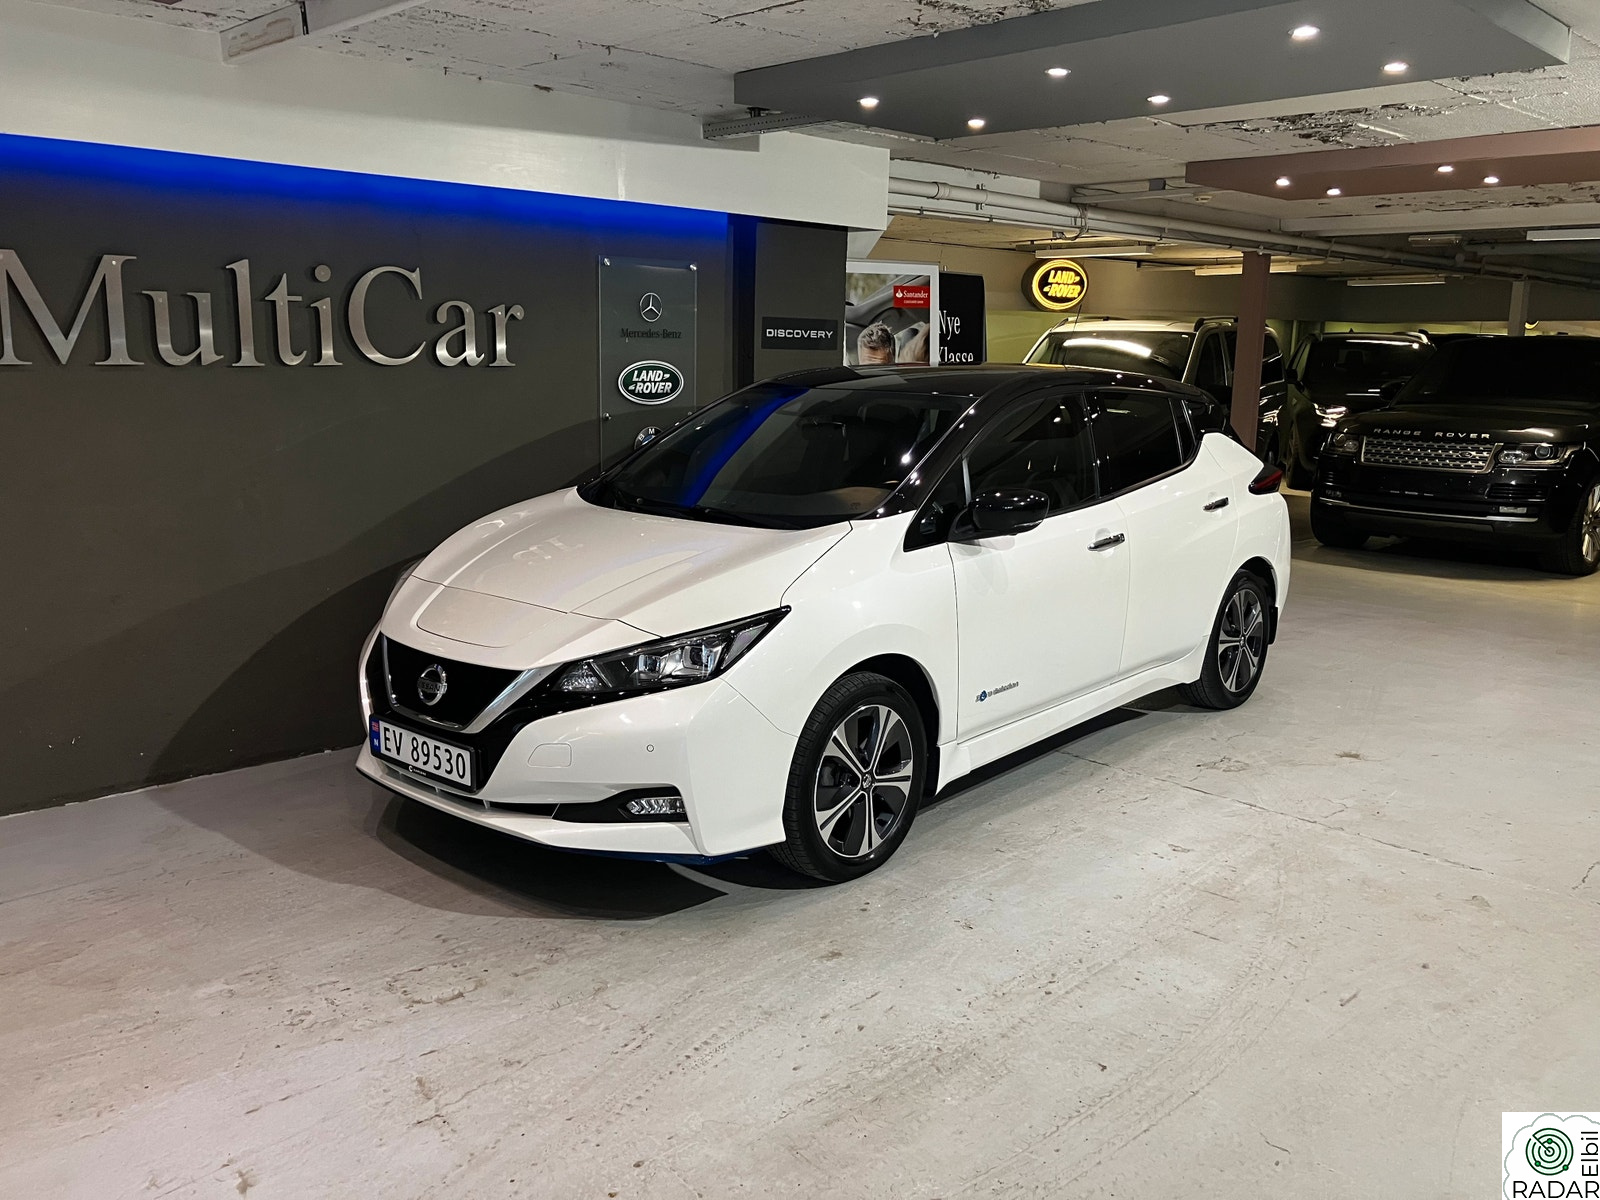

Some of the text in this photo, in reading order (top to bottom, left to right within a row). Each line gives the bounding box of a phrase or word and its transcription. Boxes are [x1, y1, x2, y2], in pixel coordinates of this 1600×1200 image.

[1048, 270, 1076, 284] LAND
[903, 290, 928, 298] Santander
[1048, 284, 1081, 298] ROVER
[0, 249, 525, 367] MultiCar
[939, 310, 961, 340] Nye
[620, 328, 682, 339] Mercedes-Benz
[766, 328, 834, 339] DISCOVERY
[632, 370, 664, 382] LAND
[634, 381, 672, 394] ROVER
[1373, 428, 1490, 439] RANGE ROVER
[383, 726, 466, 779] EV 89530
